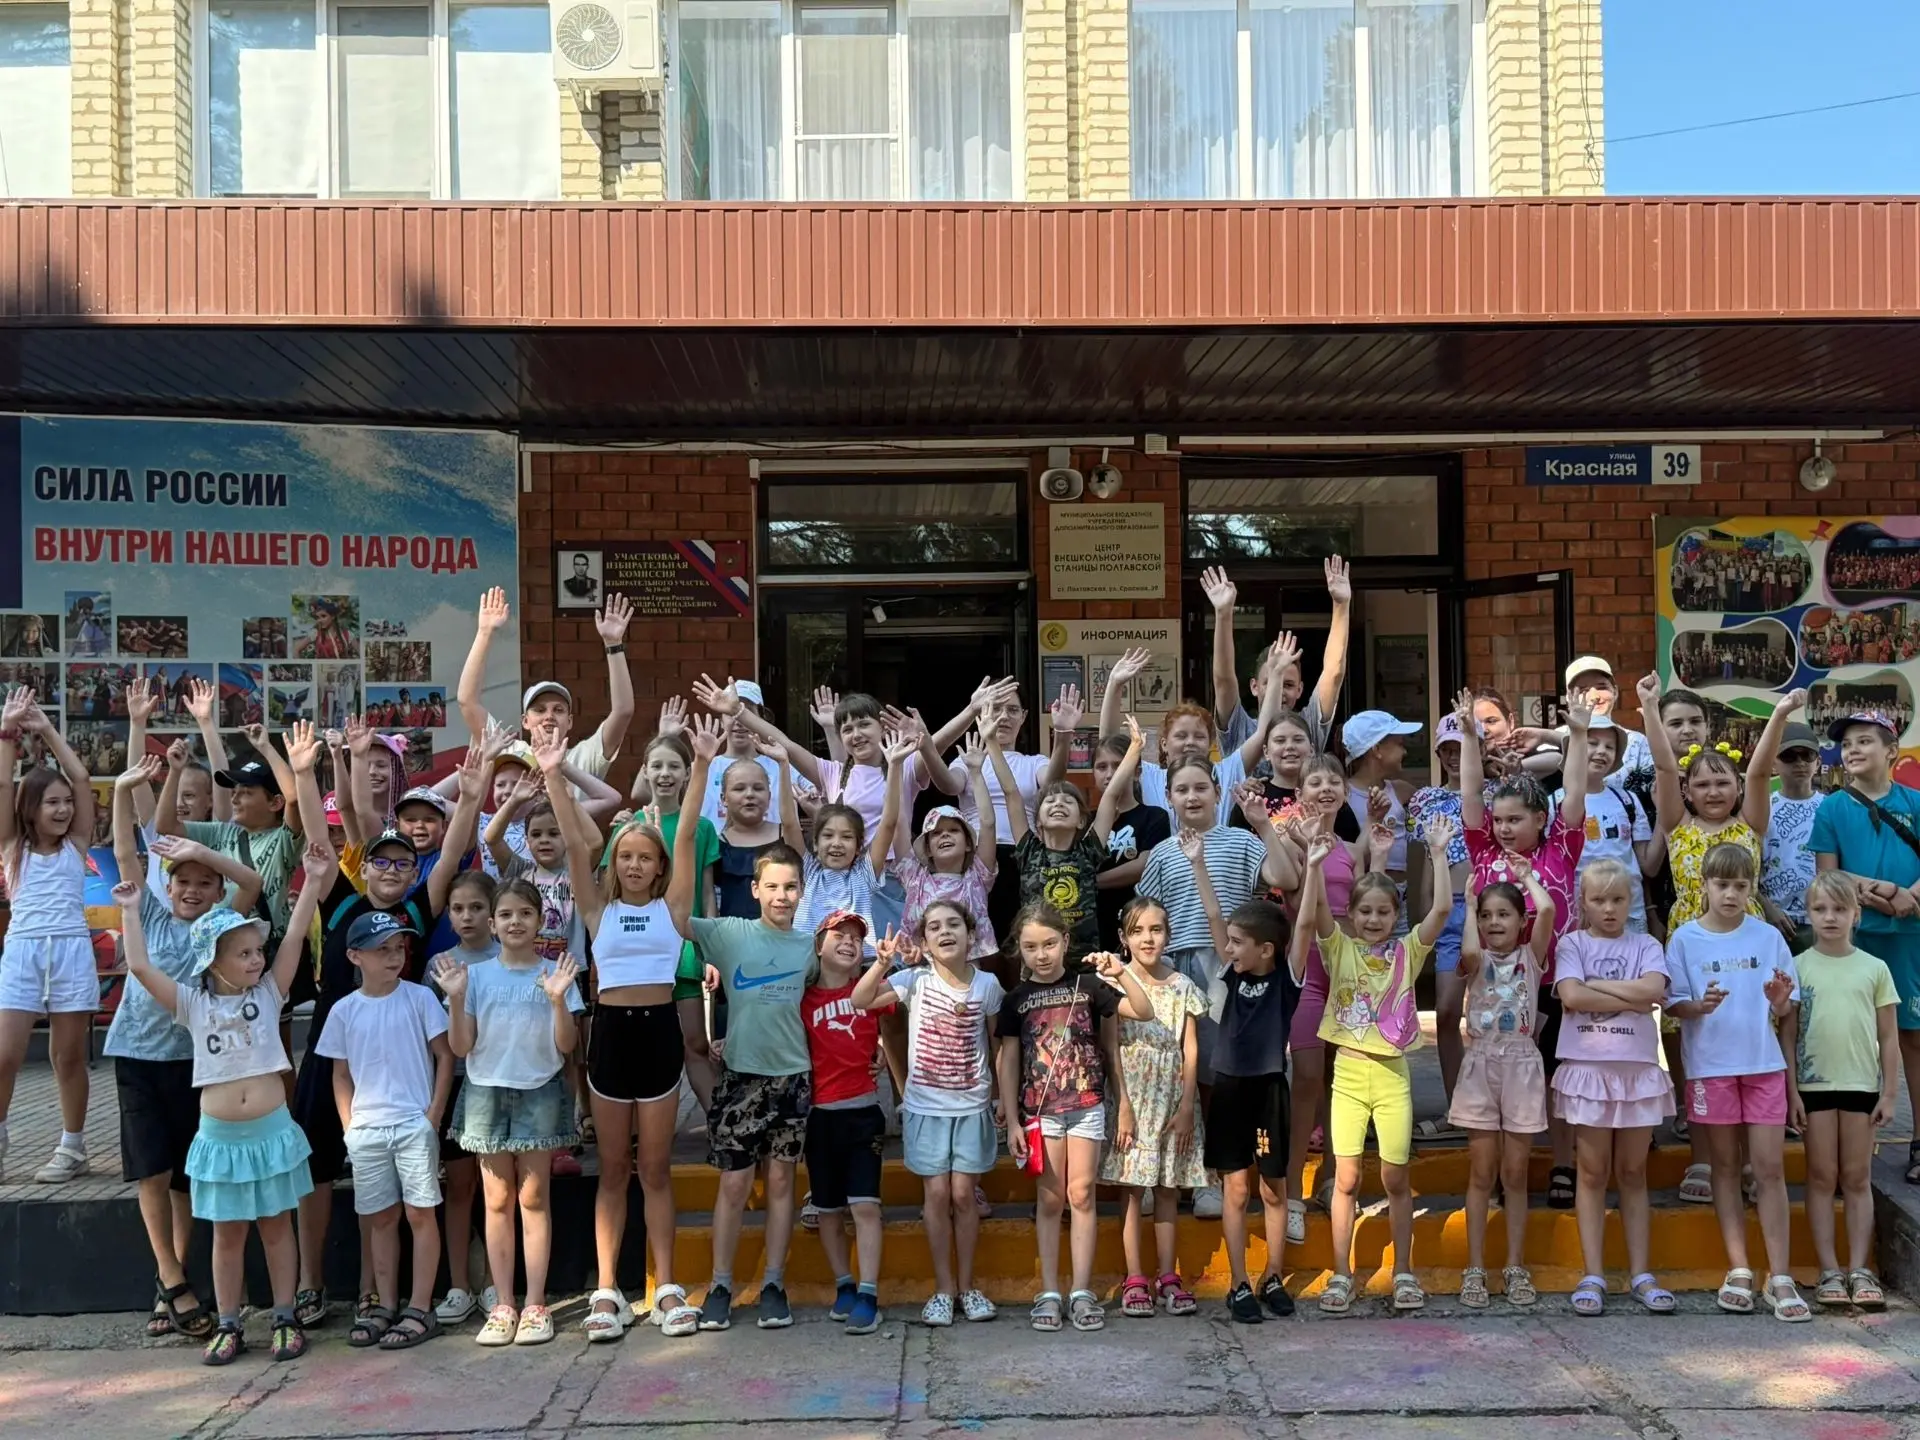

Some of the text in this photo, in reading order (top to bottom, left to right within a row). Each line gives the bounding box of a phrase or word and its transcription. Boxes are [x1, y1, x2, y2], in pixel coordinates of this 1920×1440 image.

[1545, 459, 1638, 480] Красная
[1663, 452, 1690, 478] 39
[33, 466, 288, 507] СИЛА РОССИИ
[33, 527, 478, 574] ВНУТРИ НАШЕГО НАРОДА
[1094, 543, 1121, 552] ЦЕНТР
[614, 553, 681, 561] УЧАСТКОВАЯ
[1054, 552, 1161, 562] ВНЕШКОЛЬНОЙ РАБОТЫ
[1054, 562, 1162, 573] СТАНИЦЫ ПОЛТАВСКОЙ
[619, 570, 677, 578] КОМИССИЯ
[1081, 629, 1168, 641] ИНФОРМАЦИЯ
[619, 915, 650, 924] SUMMER
[623, 924, 646, 932] MOOD
[1028, 986, 1076, 1000] MINECRAFT
[1018, 992, 1089, 1014] DUNGEONS
[1577, 1025, 1635, 1035] TIME TO CHILL
